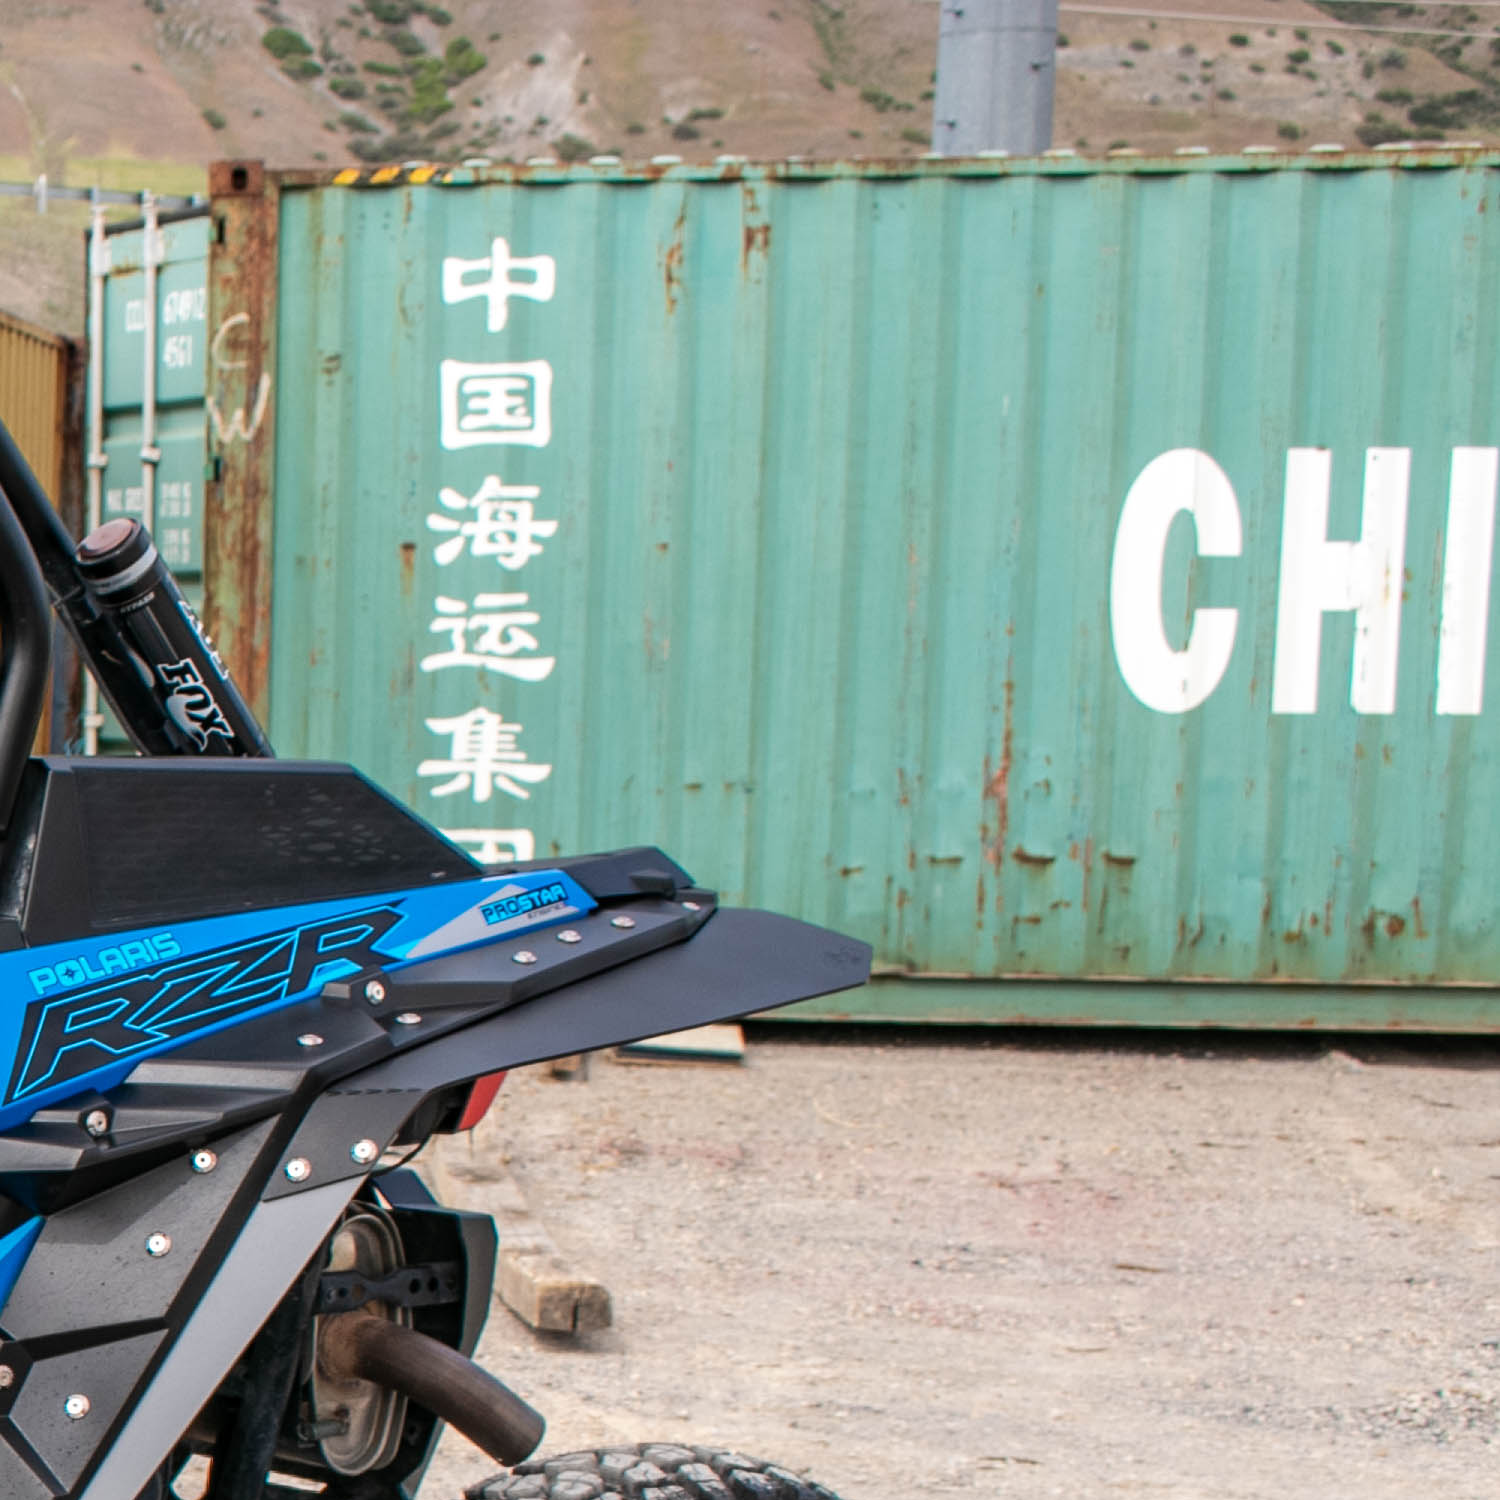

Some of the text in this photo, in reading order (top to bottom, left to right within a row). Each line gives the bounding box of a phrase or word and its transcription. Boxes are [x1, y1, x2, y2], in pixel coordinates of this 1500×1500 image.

[1110, 446, 1500, 716] CHI
[157, 657, 235, 750] FOX
[482, 884, 566, 924] PROSTAR
[4, 900, 408, 1104] RZR
[26, 932, 182, 996] POLARIS
